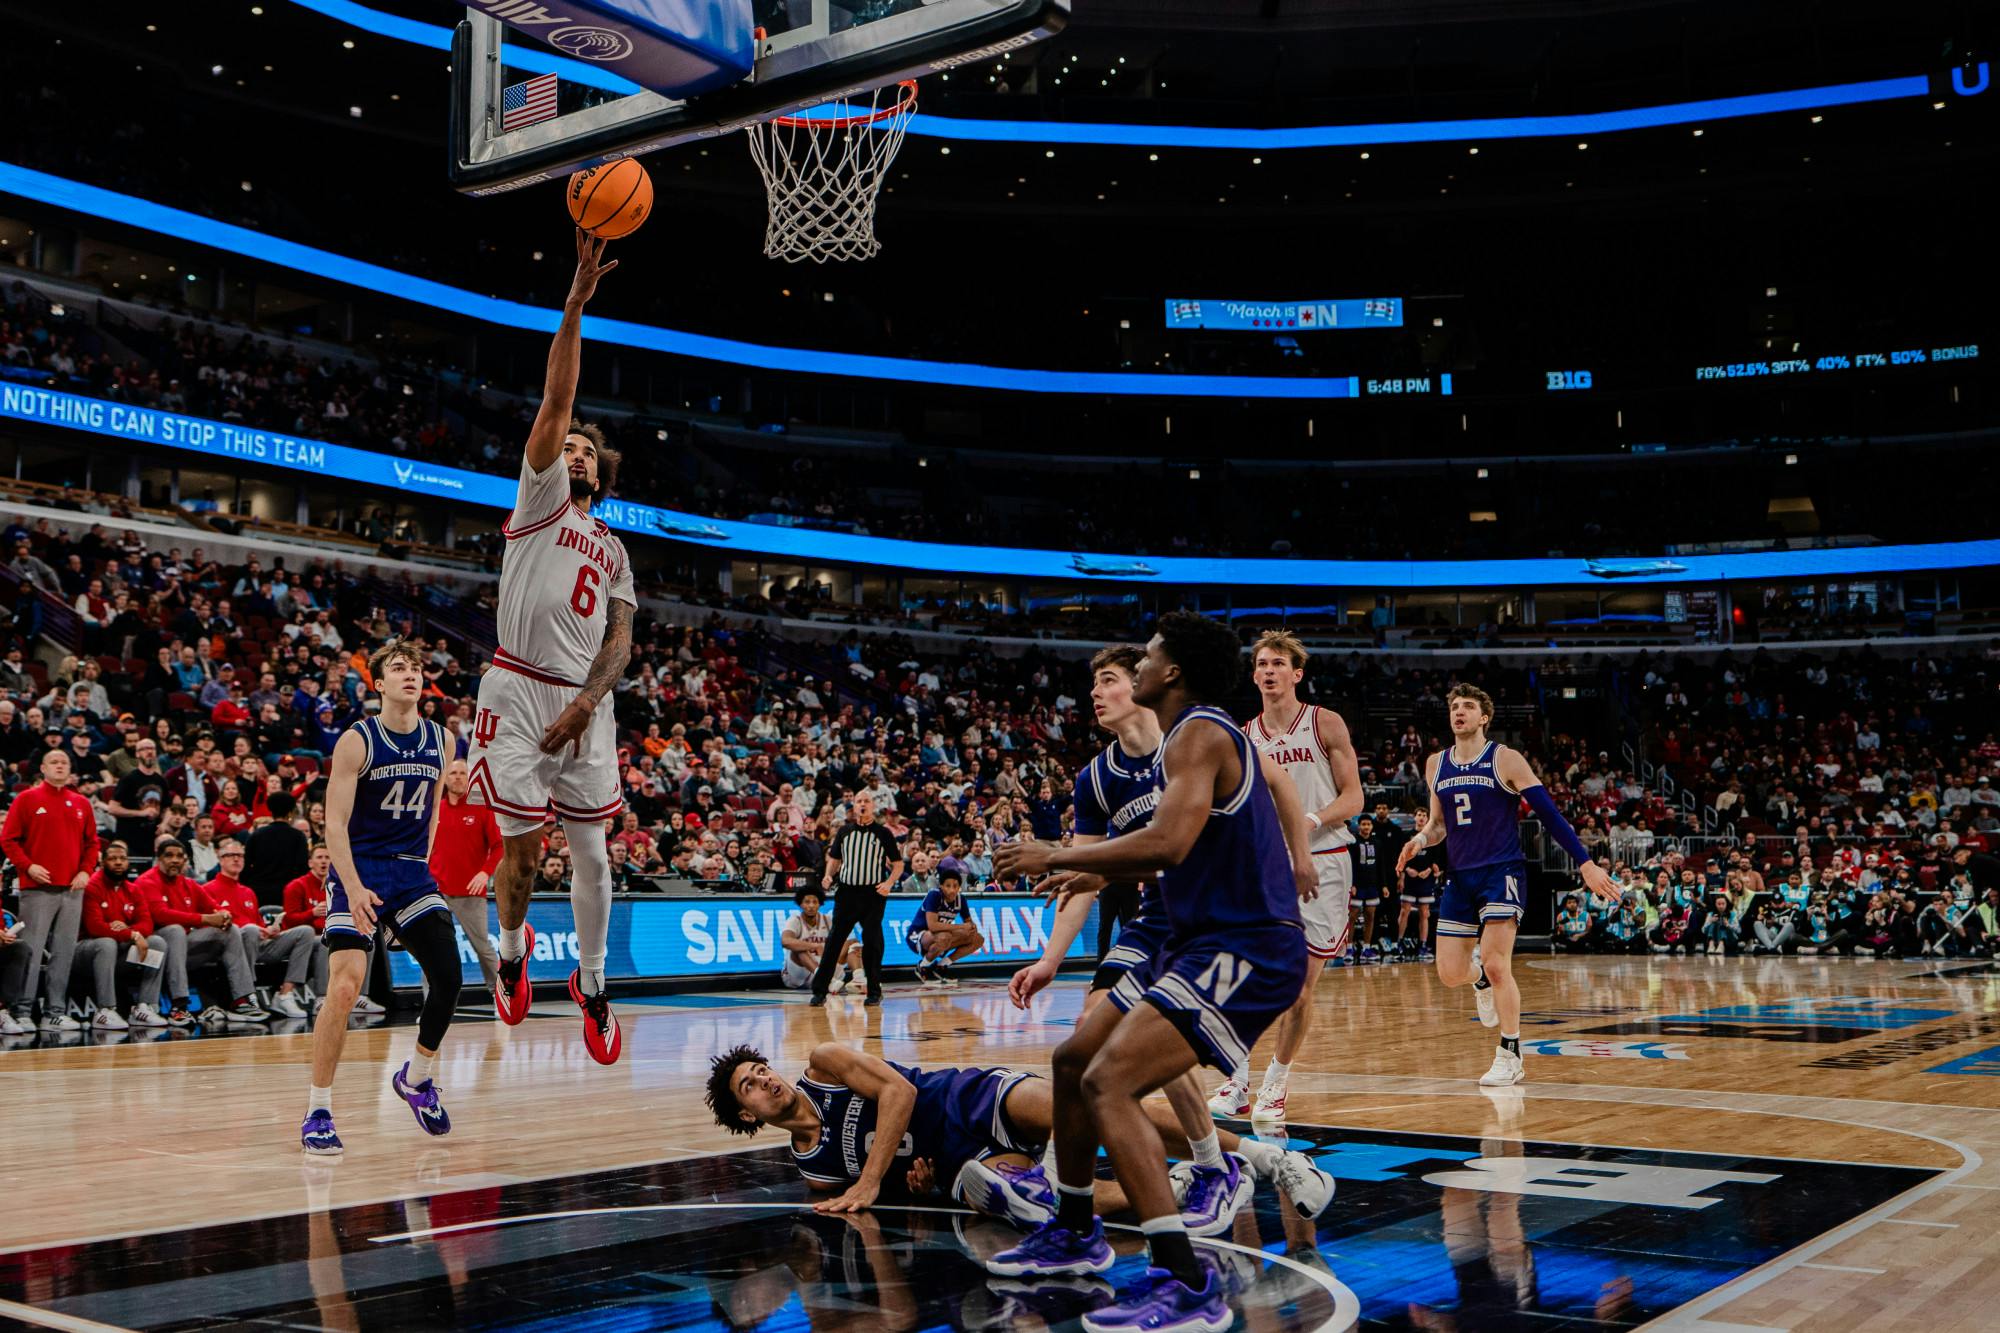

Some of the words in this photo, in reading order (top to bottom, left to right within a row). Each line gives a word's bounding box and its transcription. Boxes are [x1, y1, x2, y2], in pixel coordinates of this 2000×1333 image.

[1951, 62, 1990, 97] U
[1227, 304, 1280, 319] March
[1284, 307, 1296, 317] IS
[1771, 359, 1810, 374] 3PT%
[1816, 356, 1850, 370] 40%
[1855, 353, 1886, 367] FT%
[1891, 350, 1926, 365] 50%
[1931, 345, 1979, 362] BONUS
[1406, 378, 1431, 393] PM
[4, 386, 103, 428] NOTHING
[110, 407, 155, 437] CAN
[162, 417, 216, 447] STOP
[221, 428, 266, 457] THIS
[272, 438, 325, 468] TEAM
[627, 507, 657, 527] STO
[570, 564, 600, 618] 6
[369, 763, 440, 780] NORTHWESTERN
[1437, 775, 1495, 793] NORTHWESTERN
[380, 780, 429, 820] 44
[1454, 793, 1472, 826] 2
[969, 906, 1050, 955] MAX
[1194, 951, 1254, 1008] N
